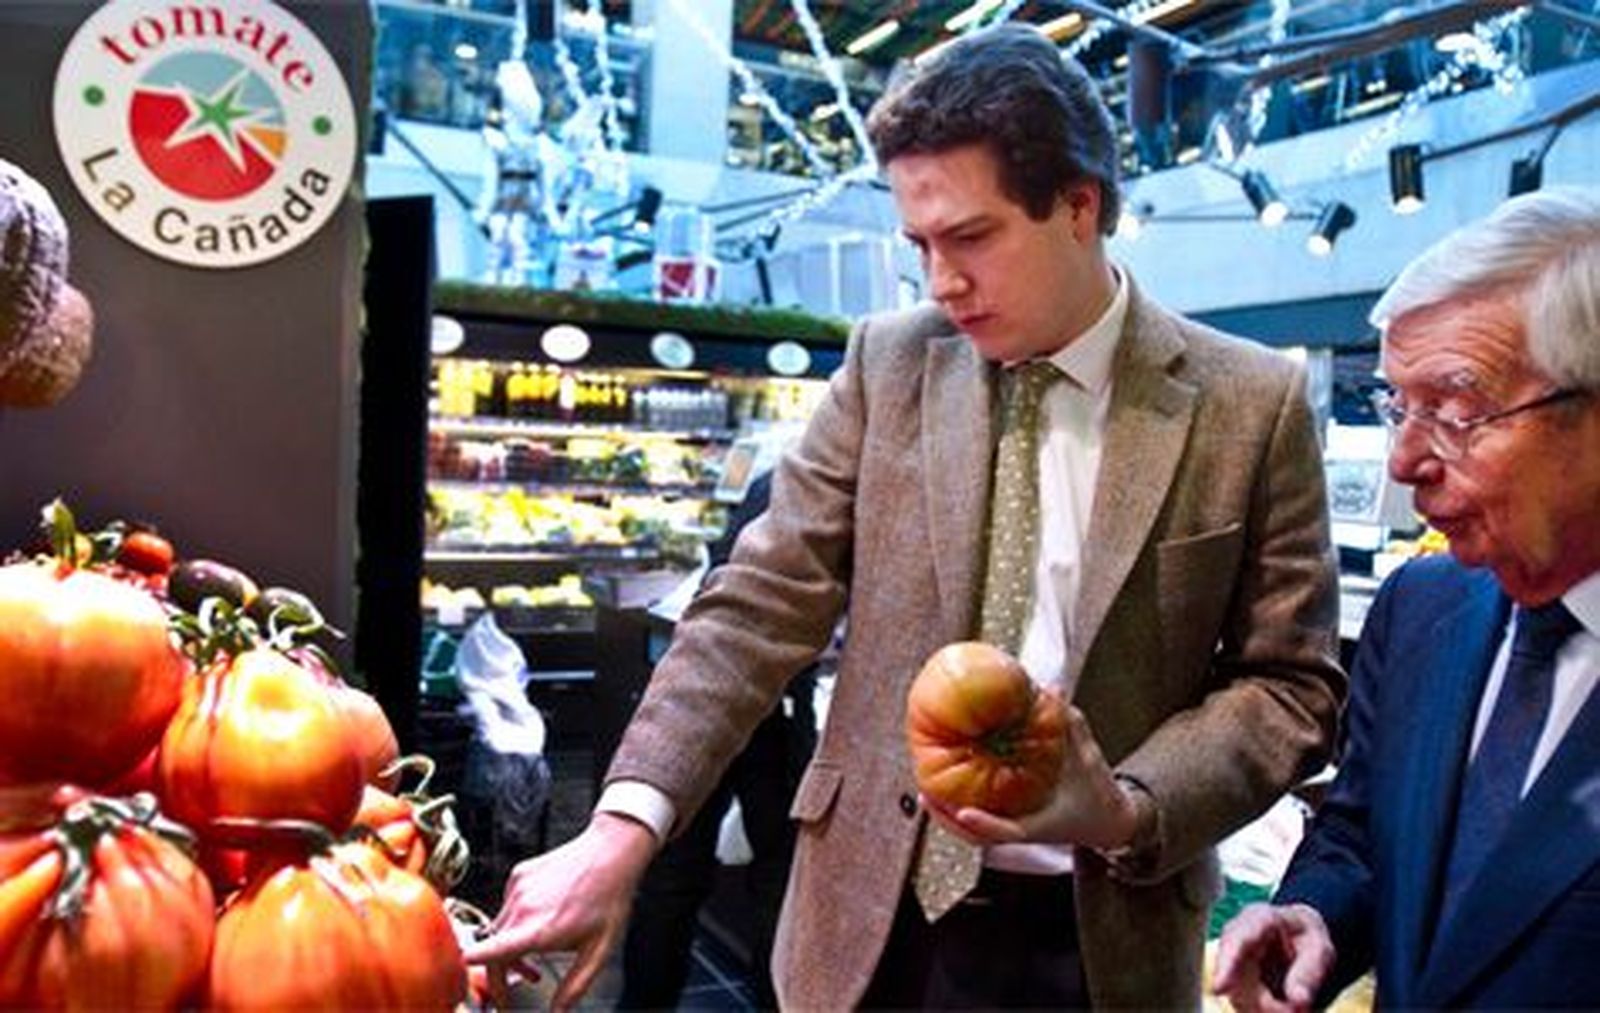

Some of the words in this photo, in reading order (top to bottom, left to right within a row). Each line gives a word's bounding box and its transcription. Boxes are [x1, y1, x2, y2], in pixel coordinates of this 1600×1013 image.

[98, 6, 314, 90] tomate
[82, 147, 136, 213] La
[153, 167, 332, 252] Cañada
